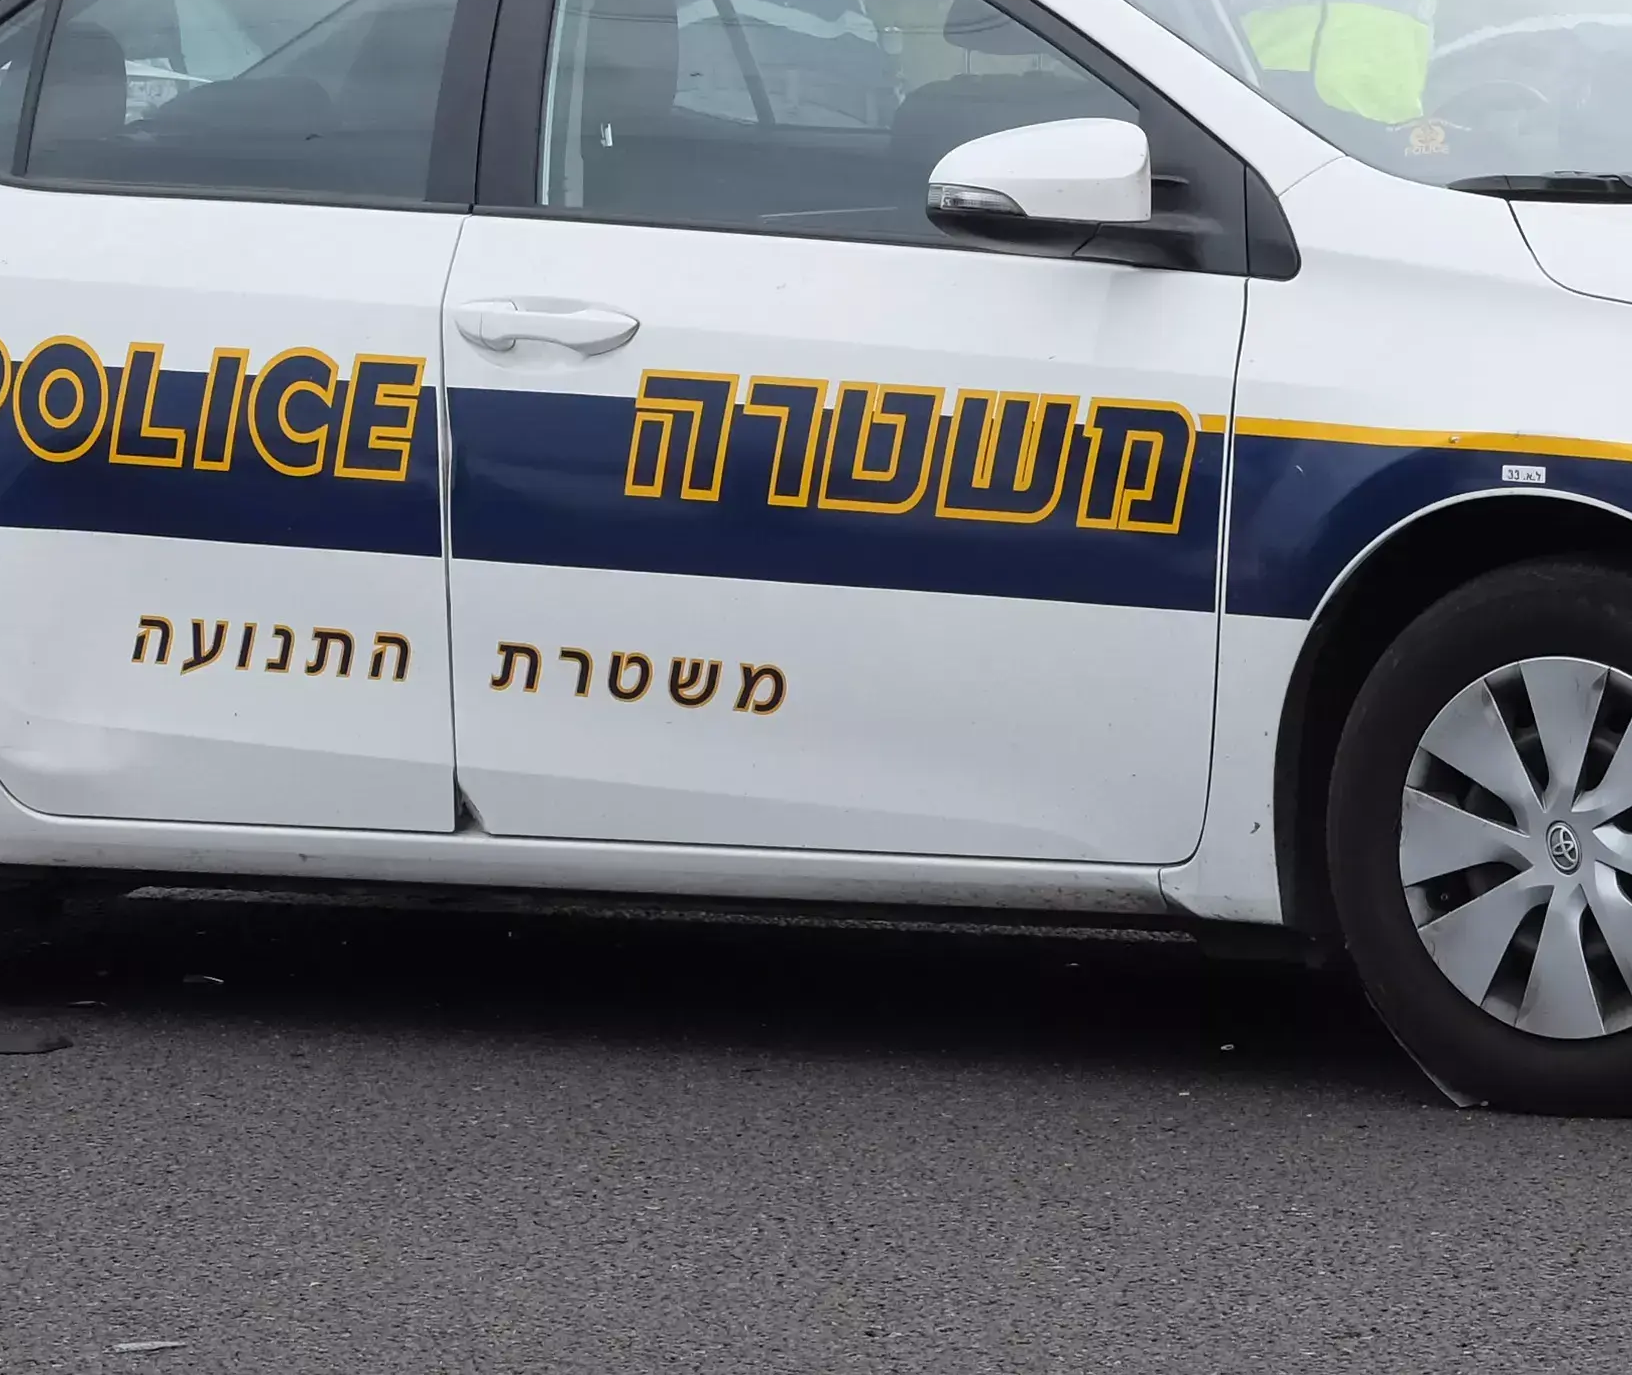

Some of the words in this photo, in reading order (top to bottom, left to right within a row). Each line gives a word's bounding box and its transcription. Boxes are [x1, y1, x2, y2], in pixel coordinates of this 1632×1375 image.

[624, 368, 1197, 535] משטרה
[130, 615, 413, 683] התנועה
[489, 640, 788, 716] משטרת
